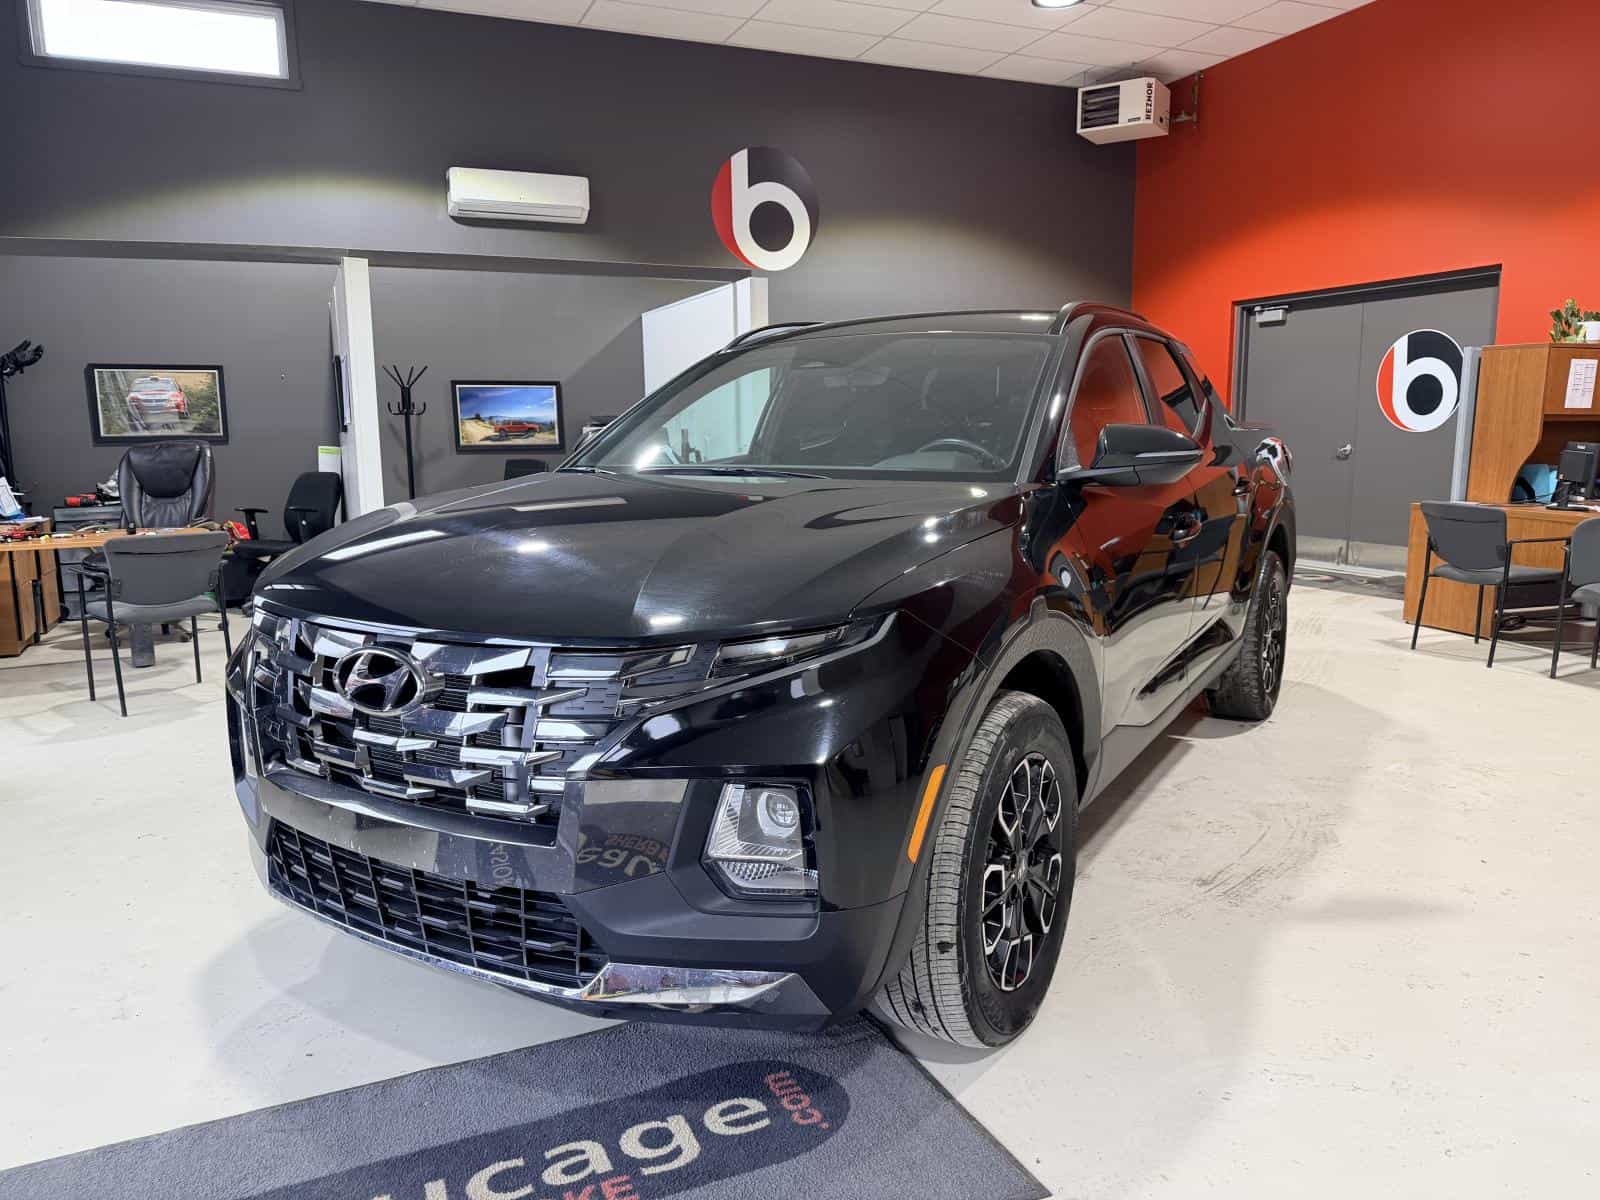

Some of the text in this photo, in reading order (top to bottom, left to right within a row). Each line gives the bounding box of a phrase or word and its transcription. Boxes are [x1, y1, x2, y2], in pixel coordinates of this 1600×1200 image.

[1145, 82, 1154, 120] REZNOR
[730, 147, 811, 271] b
[1392, 334, 1459, 432] b
